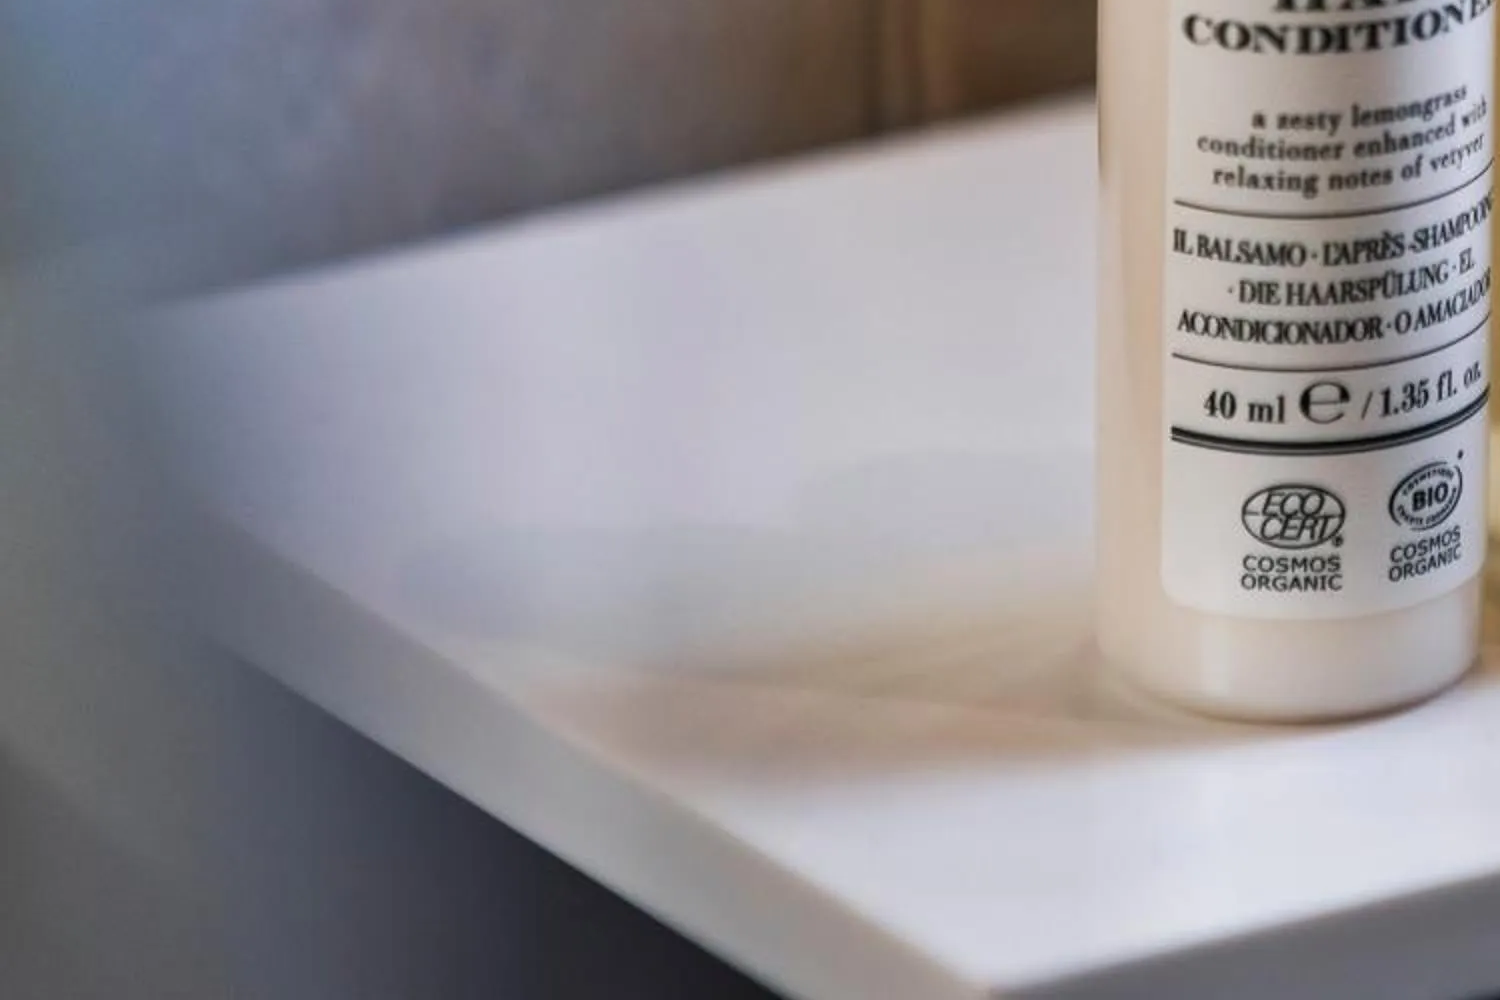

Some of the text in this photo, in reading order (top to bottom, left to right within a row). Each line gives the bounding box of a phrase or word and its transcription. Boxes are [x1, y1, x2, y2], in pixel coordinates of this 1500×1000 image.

[1197, 135, 1344, 161] conditioner
[1354, 118, 1456, 158] enhanced
[1252, 111, 1265, 128] a
[1277, 109, 1342, 136] zesty
[1212, 165, 1319, 199] relaxing
[1327, 167, 1393, 191] notes
[1400, 153, 1424, 181] of
[1173, 228, 1192, 253] IL
[1196, 234, 1306, 267] BALSAMO
[1238, 279, 1281, 305] DIE
[1286, 262, 1449, 306] HAARSPÜLUNG
[1459, 248, 1475, 275] EL
[1177, 309, 1384, 345] ACONDICIONADOR
[1394, 312, 1411, 335] O
[1203, 390, 1237, 419] 40
[1247, 394, 1286, 424] ml
[1380, 384, 1430, 418] 1.35
[1262, 491, 1323, 516] ECO
[1412, 482, 1448, 512] BIO
[1260, 515, 1335, 541] CERT
[1389, 525, 1461, 563] COSMOS
[1242, 555, 1342, 575] COSMOS
[1388, 543, 1461, 582] ORGANIC
[1241, 573, 1344, 593] ORGANIC
